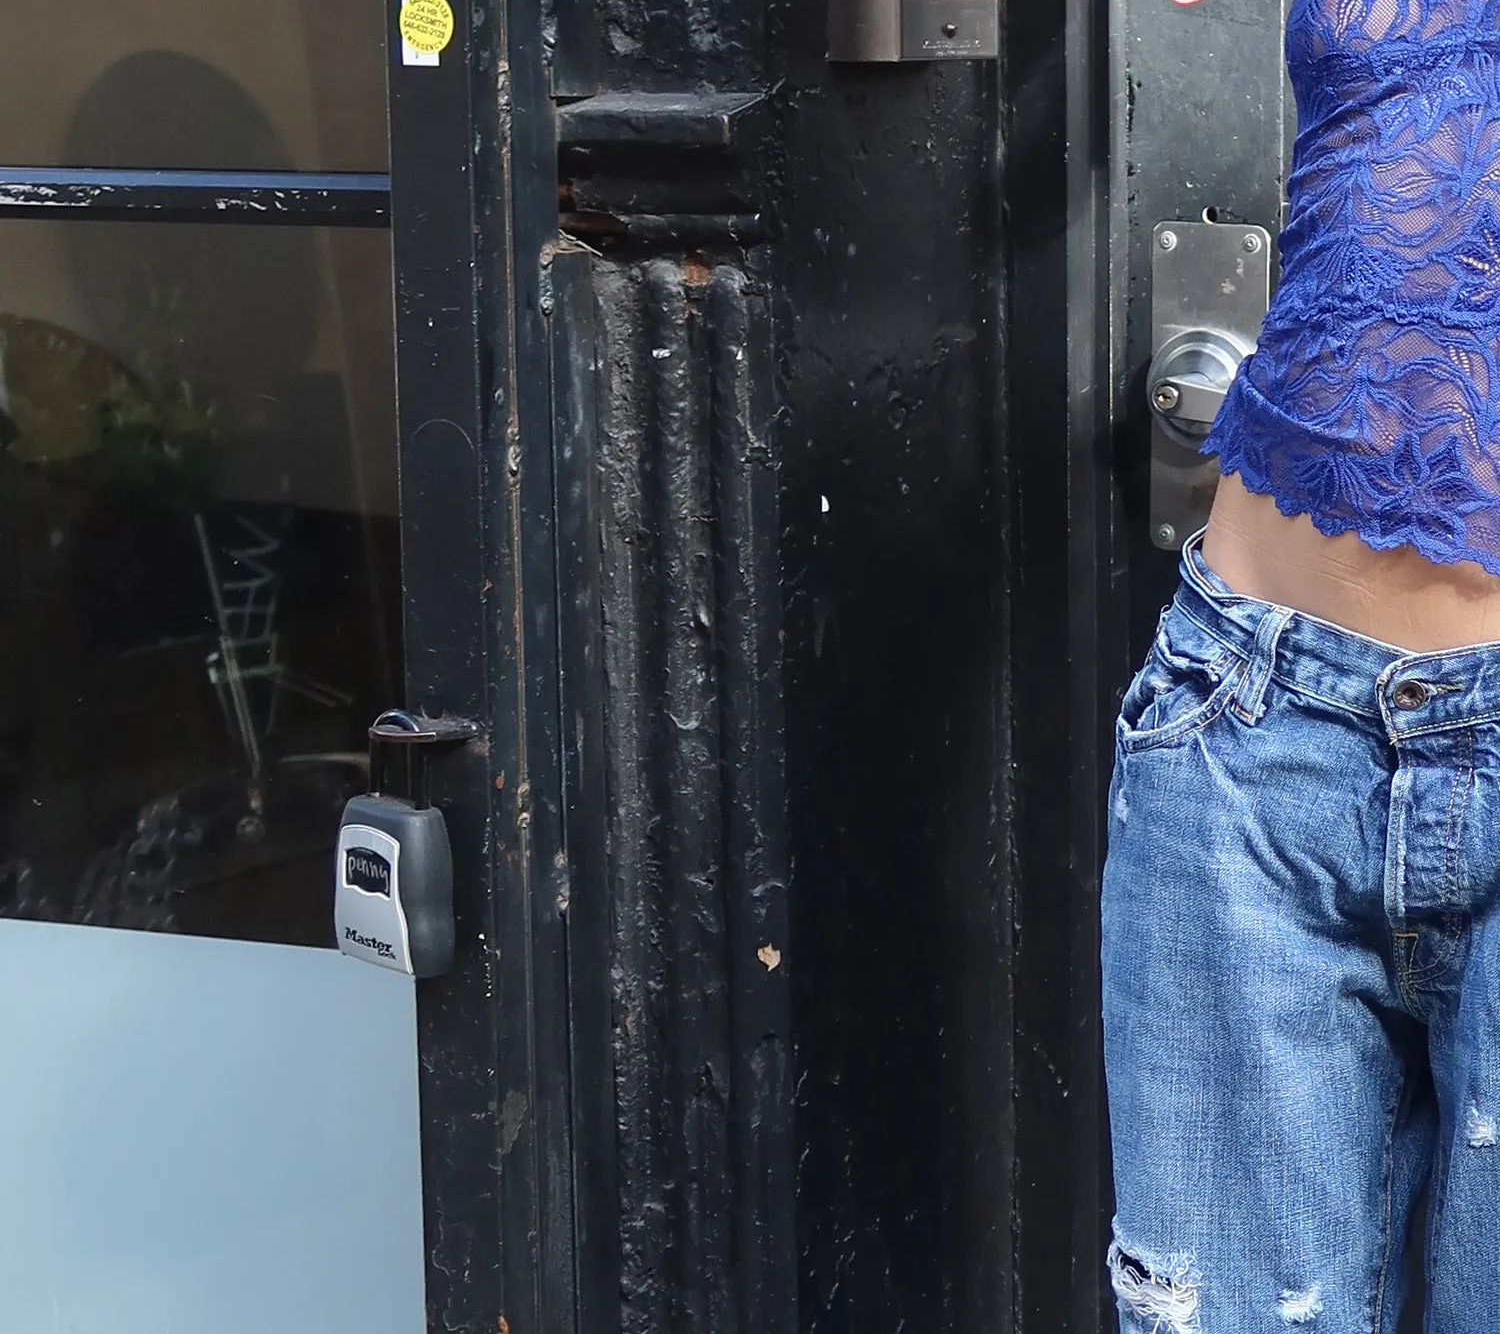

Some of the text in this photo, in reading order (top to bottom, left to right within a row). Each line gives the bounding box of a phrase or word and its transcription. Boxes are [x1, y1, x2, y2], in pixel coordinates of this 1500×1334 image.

[404, 10, 447, 29] LOCKSMITH
[347, 856, 389, 893] penny
[344, 927, 393, 952] Master
